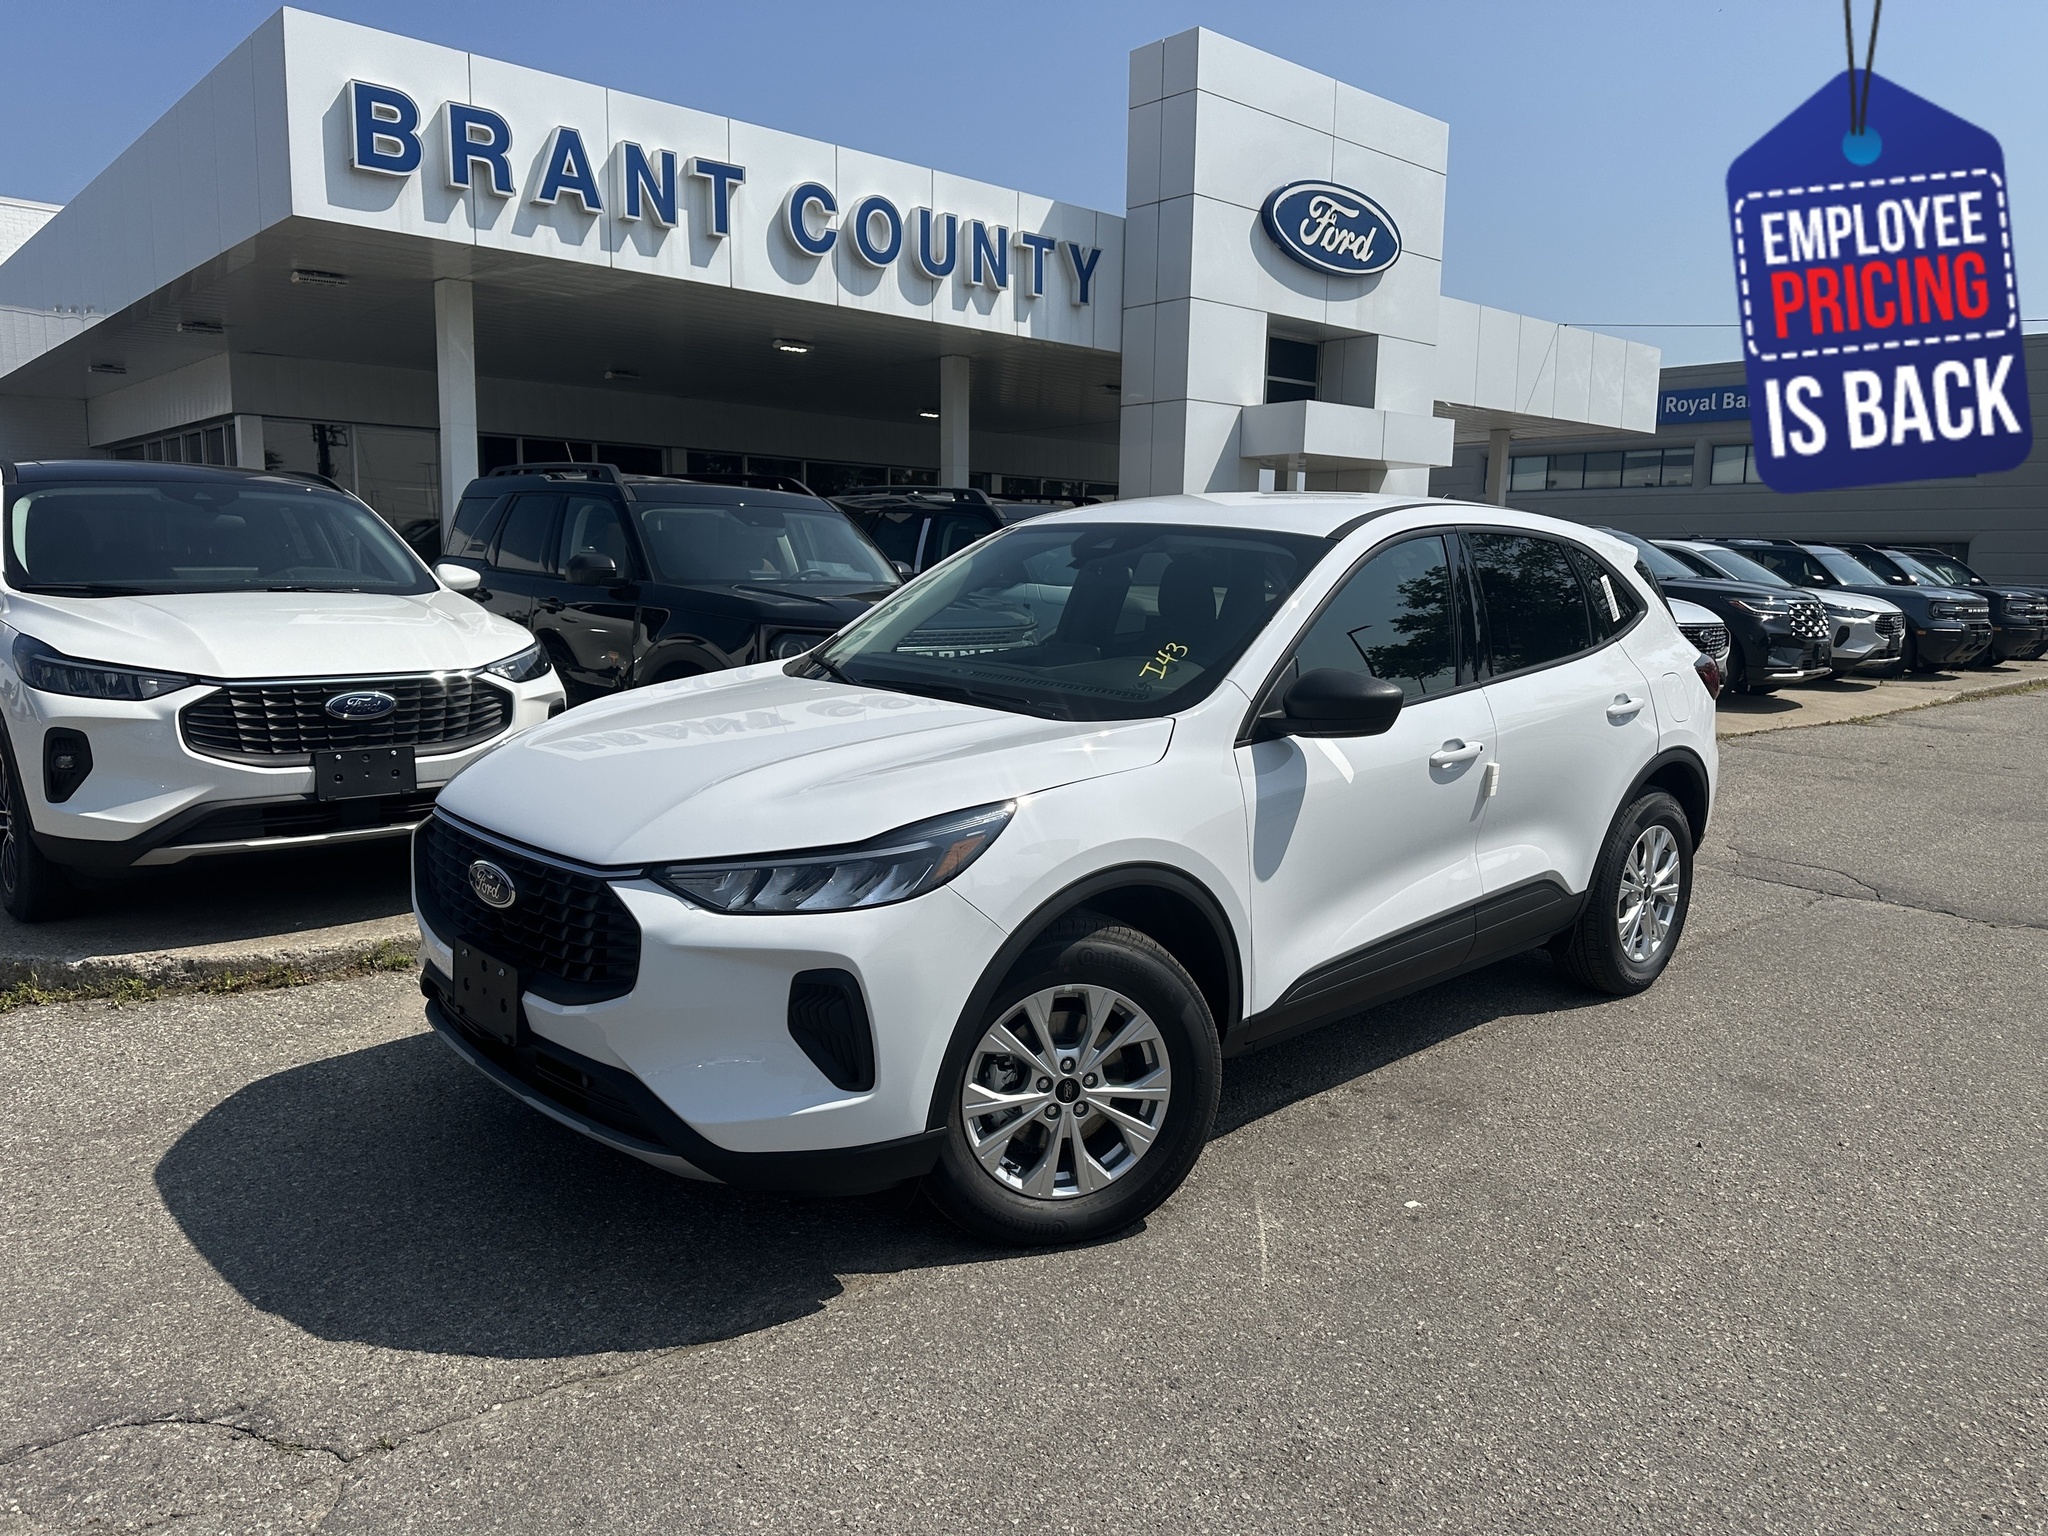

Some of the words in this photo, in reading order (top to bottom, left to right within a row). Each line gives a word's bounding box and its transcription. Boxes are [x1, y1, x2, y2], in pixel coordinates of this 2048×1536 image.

[348, 78, 746, 238] BRANT
[783, 181, 1104, 307] COUNTY
[1300, 195, 1377, 262] Ford
[1665, 393, 1716, 416] Royal
[1722, 392, 1750, 410] Ba
